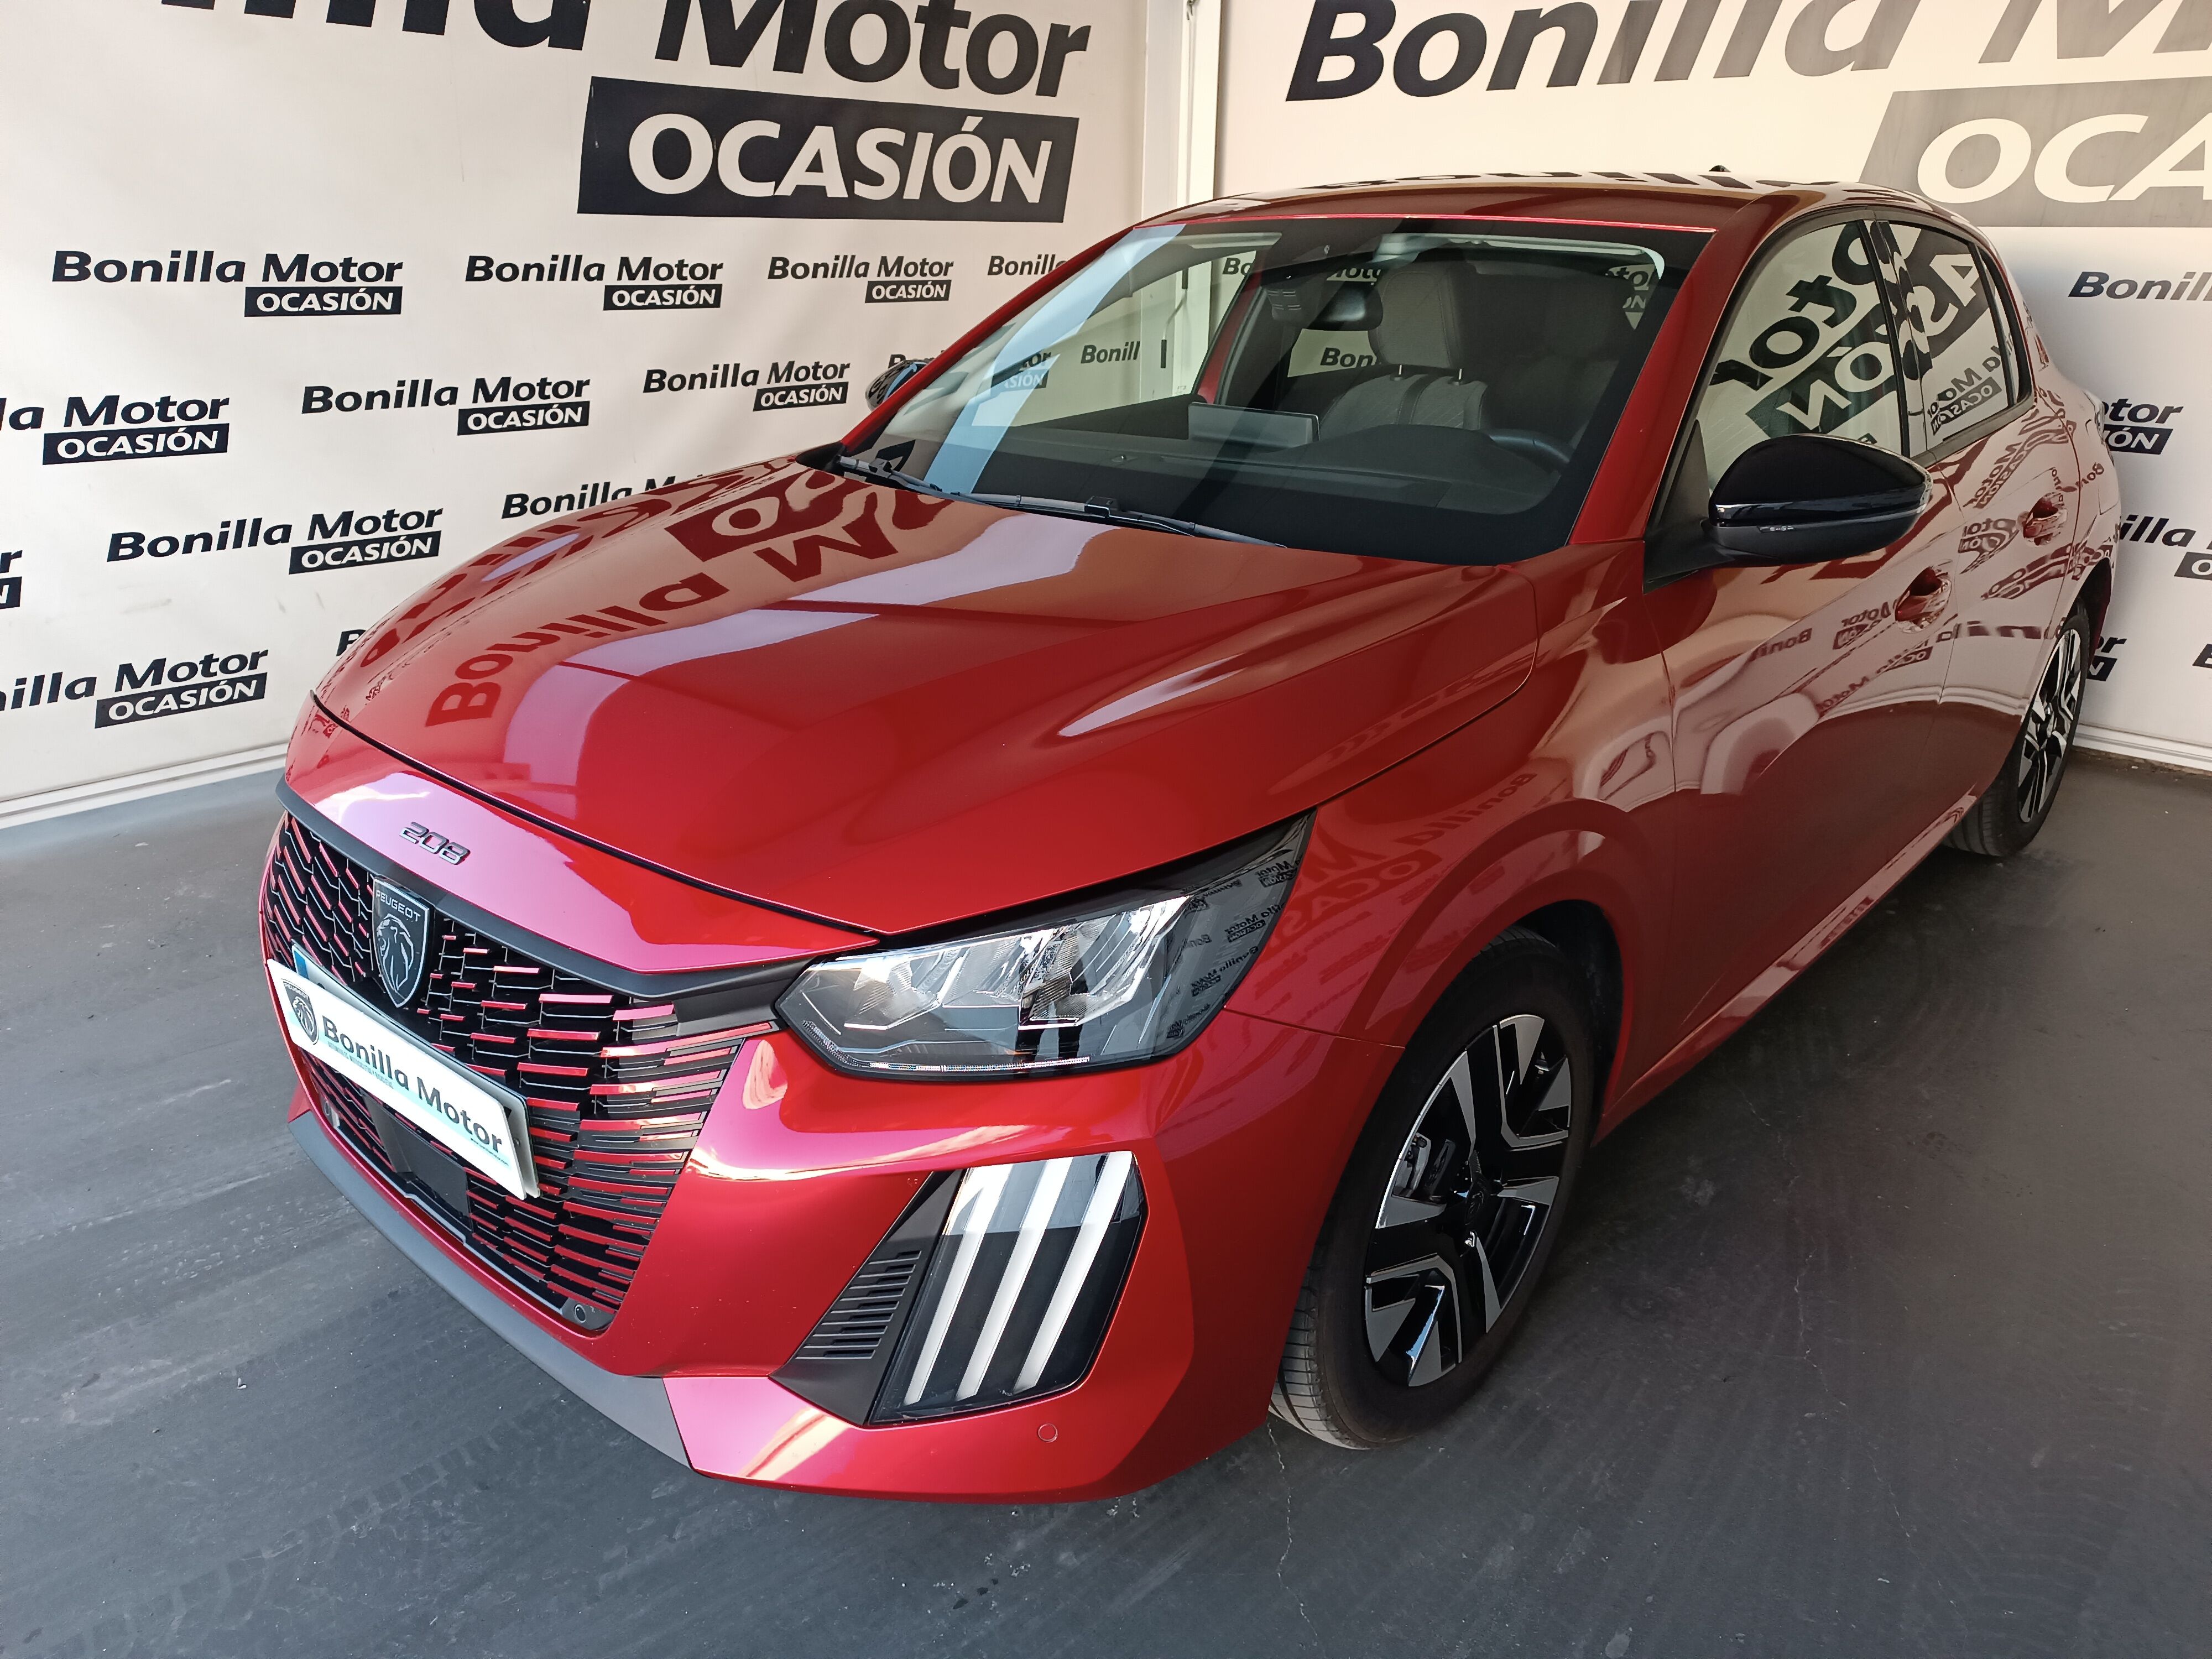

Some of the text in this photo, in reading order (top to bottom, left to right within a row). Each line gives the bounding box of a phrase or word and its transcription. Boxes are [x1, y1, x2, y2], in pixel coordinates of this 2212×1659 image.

[654, 0, 1091, 97] Motor
[629, 113, 1052, 203] OCASIÓN
[52, 251, 403, 283] Bonilla Motor
[465, 255, 723, 282] Bonilla Motor
[768, 255, 954, 279] Bonilla Motor
[257, 289, 393, 312] OCASIÓN
[612, 285, 716, 306] OCASIÓN
[872, 281, 946, 299] OCASIÓN
[2068, 272, 2212, 301] Bonil
[1081, 341, 1140, 364] Bonill
[643, 361, 850, 393] Bonilla Motor
[64, 395, 229, 427] Motor
[302, 377, 590, 414] Bonilla Motor
[761, 384, 842, 407] OCASIÓN
[2102, 398, 2184, 424] tor
[468, 404, 582, 430] OCASIÓN
[58, 427, 218, 458] OCASIÓN
[107, 508, 443, 562] Bonilla Motor
[2120, 515, 2196, 547] illa
[301, 536, 432, 568] OCASIÓN
[0, 650, 268, 711] illa Motor
[108, 680, 257, 720] OCASIÓN
[399, 822, 471, 865] 208
[375, 890, 421, 922] PEUGEOT
[322, 1015, 409, 1091] Bonilla
[417, 1077, 502, 1153] Motor
